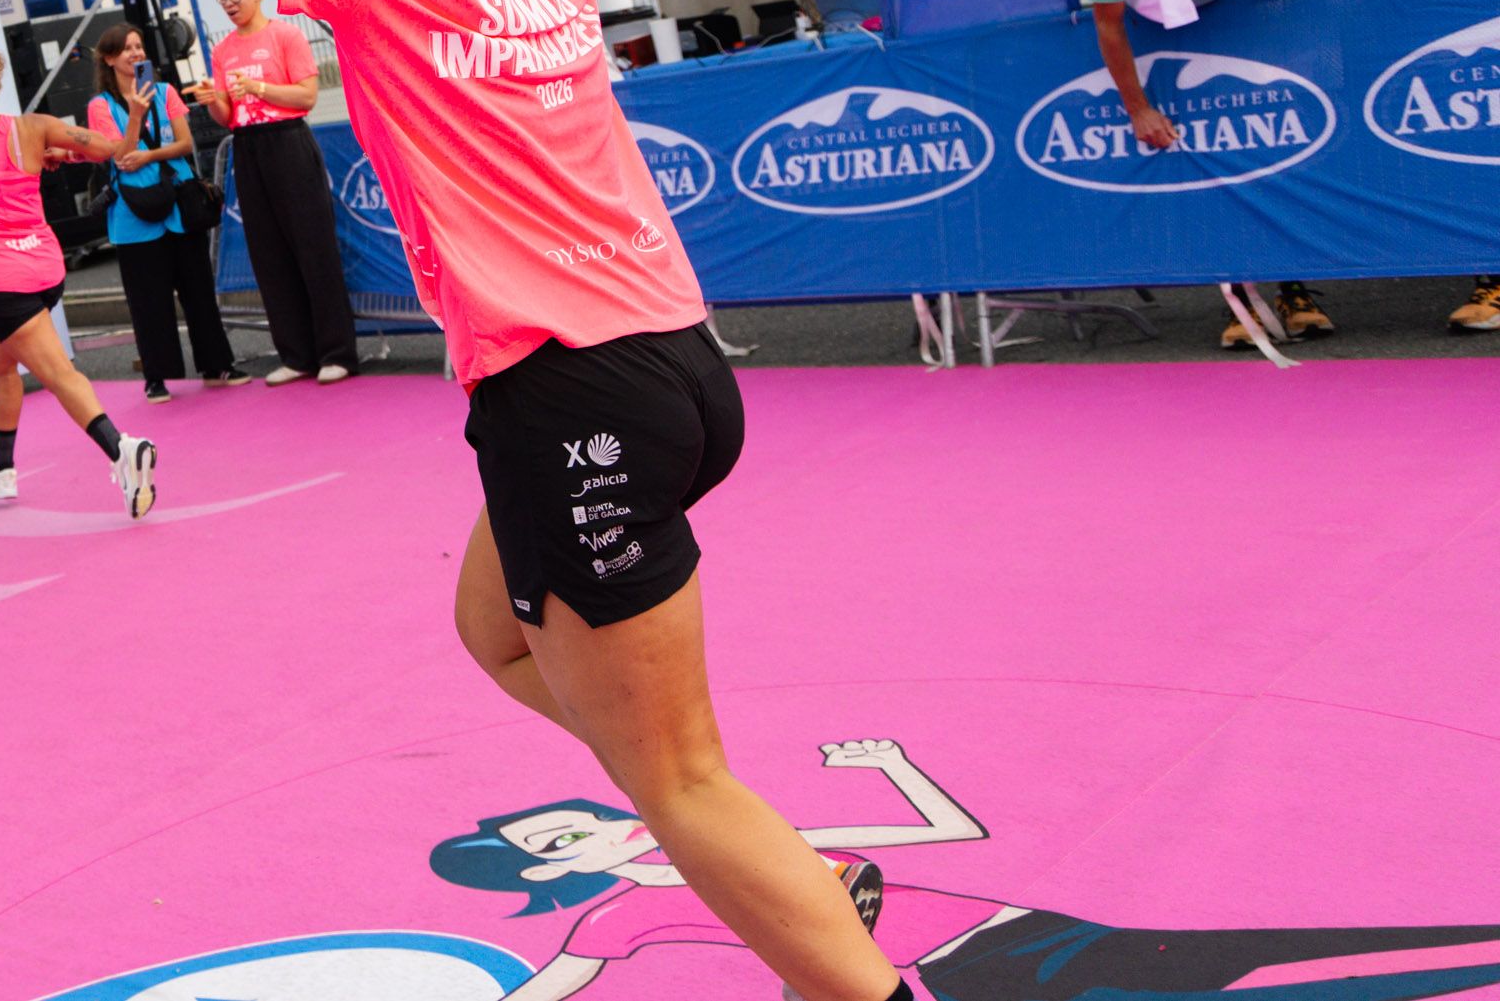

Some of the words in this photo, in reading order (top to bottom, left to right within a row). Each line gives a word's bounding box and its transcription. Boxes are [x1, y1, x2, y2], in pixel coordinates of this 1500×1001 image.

[536, 77, 574, 110] 2026
[1083, 102, 1179, 120] CENL
[1186, 88, 1295, 113] LECHERA
[787, 130, 869, 150] CENTRAL
[875, 120, 963, 140] LECHERA
[750, 138, 974, 189] ASTURIANA
[562, 440, 588, 469] X
[570, 473, 629, 498] galicia
[587, 502, 615, 514] XUNTA
[588, 513, 600, 521] DE
[601, 506, 632, 519] GALICIA
